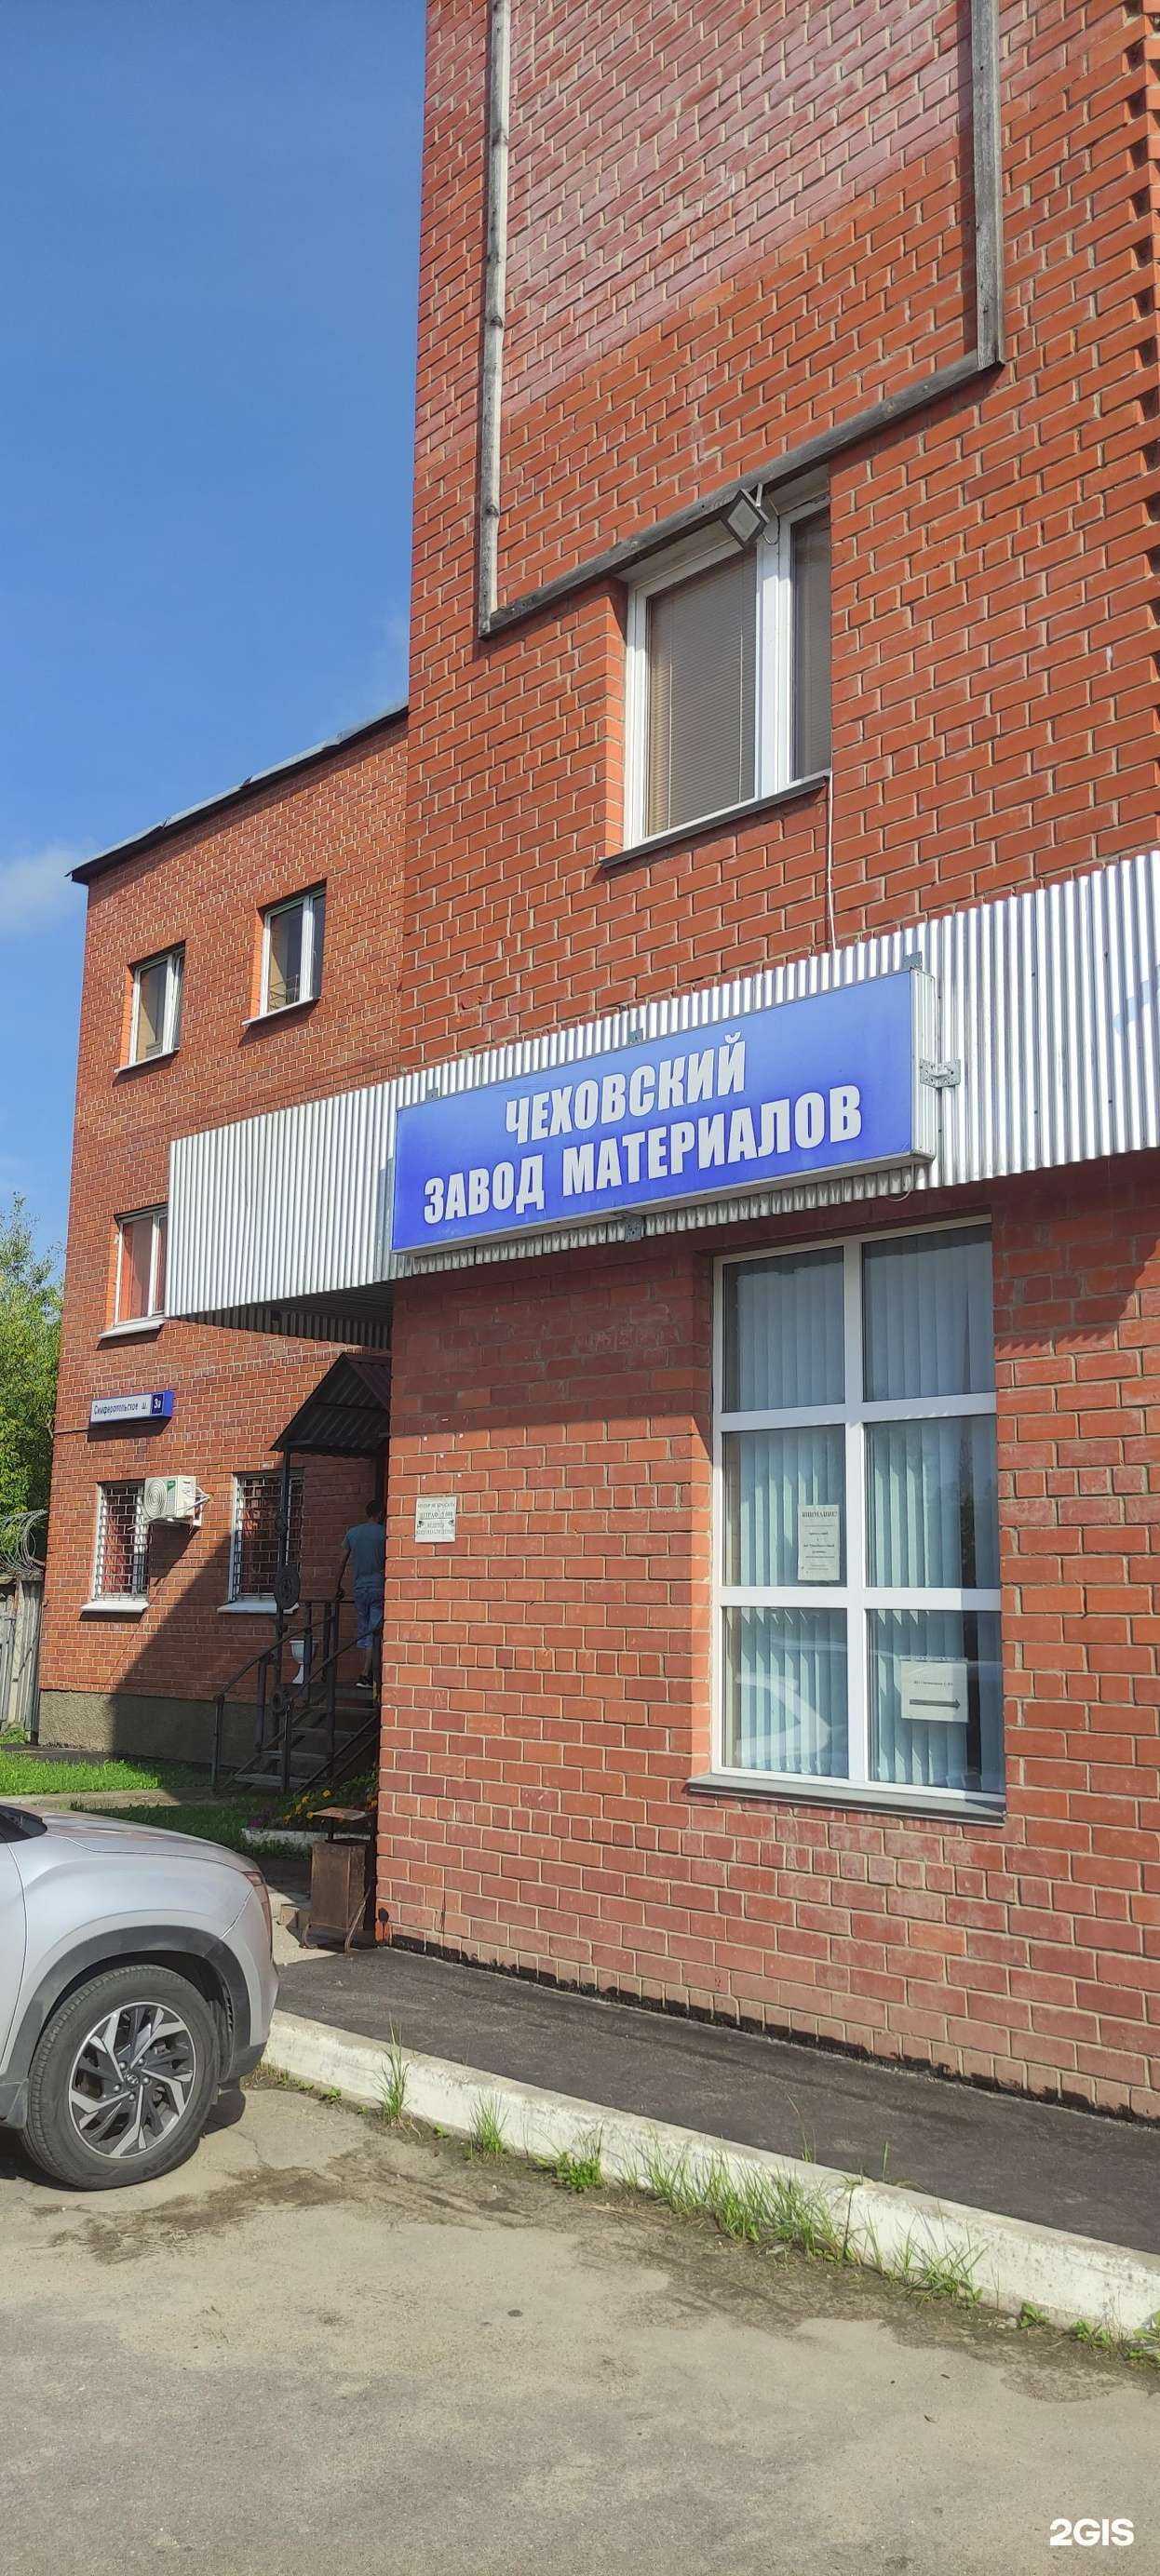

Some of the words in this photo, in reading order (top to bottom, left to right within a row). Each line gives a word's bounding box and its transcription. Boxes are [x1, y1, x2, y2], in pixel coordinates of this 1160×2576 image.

[506, 1031, 747, 1145] ЧЕХОВСКИЙ
[423, 1154, 546, 1225] ЗАВОД
[561, 1084, 863, 1198] МАТЕРИАЛОВ
